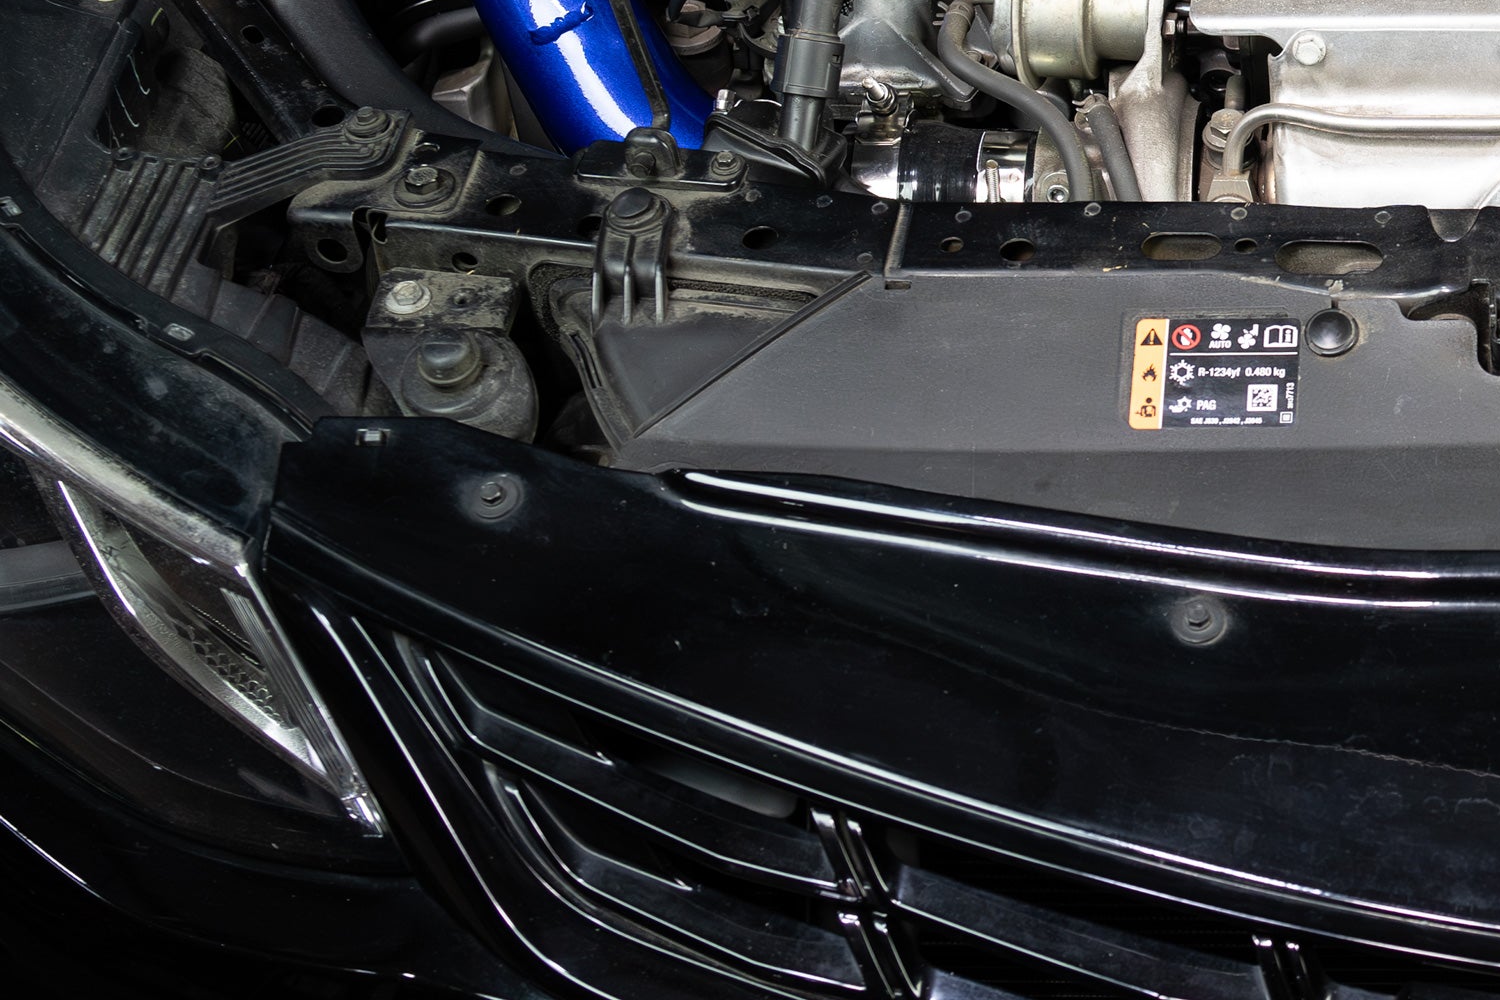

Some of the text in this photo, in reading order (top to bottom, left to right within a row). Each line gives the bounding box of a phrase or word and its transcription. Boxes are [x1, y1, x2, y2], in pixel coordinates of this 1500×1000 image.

[1208, 340, 1232, 349] AUTO
[1197, 366, 1286, 379] R-1234yf 0.480 kg
[1196, 399, 1217, 411] PAG
